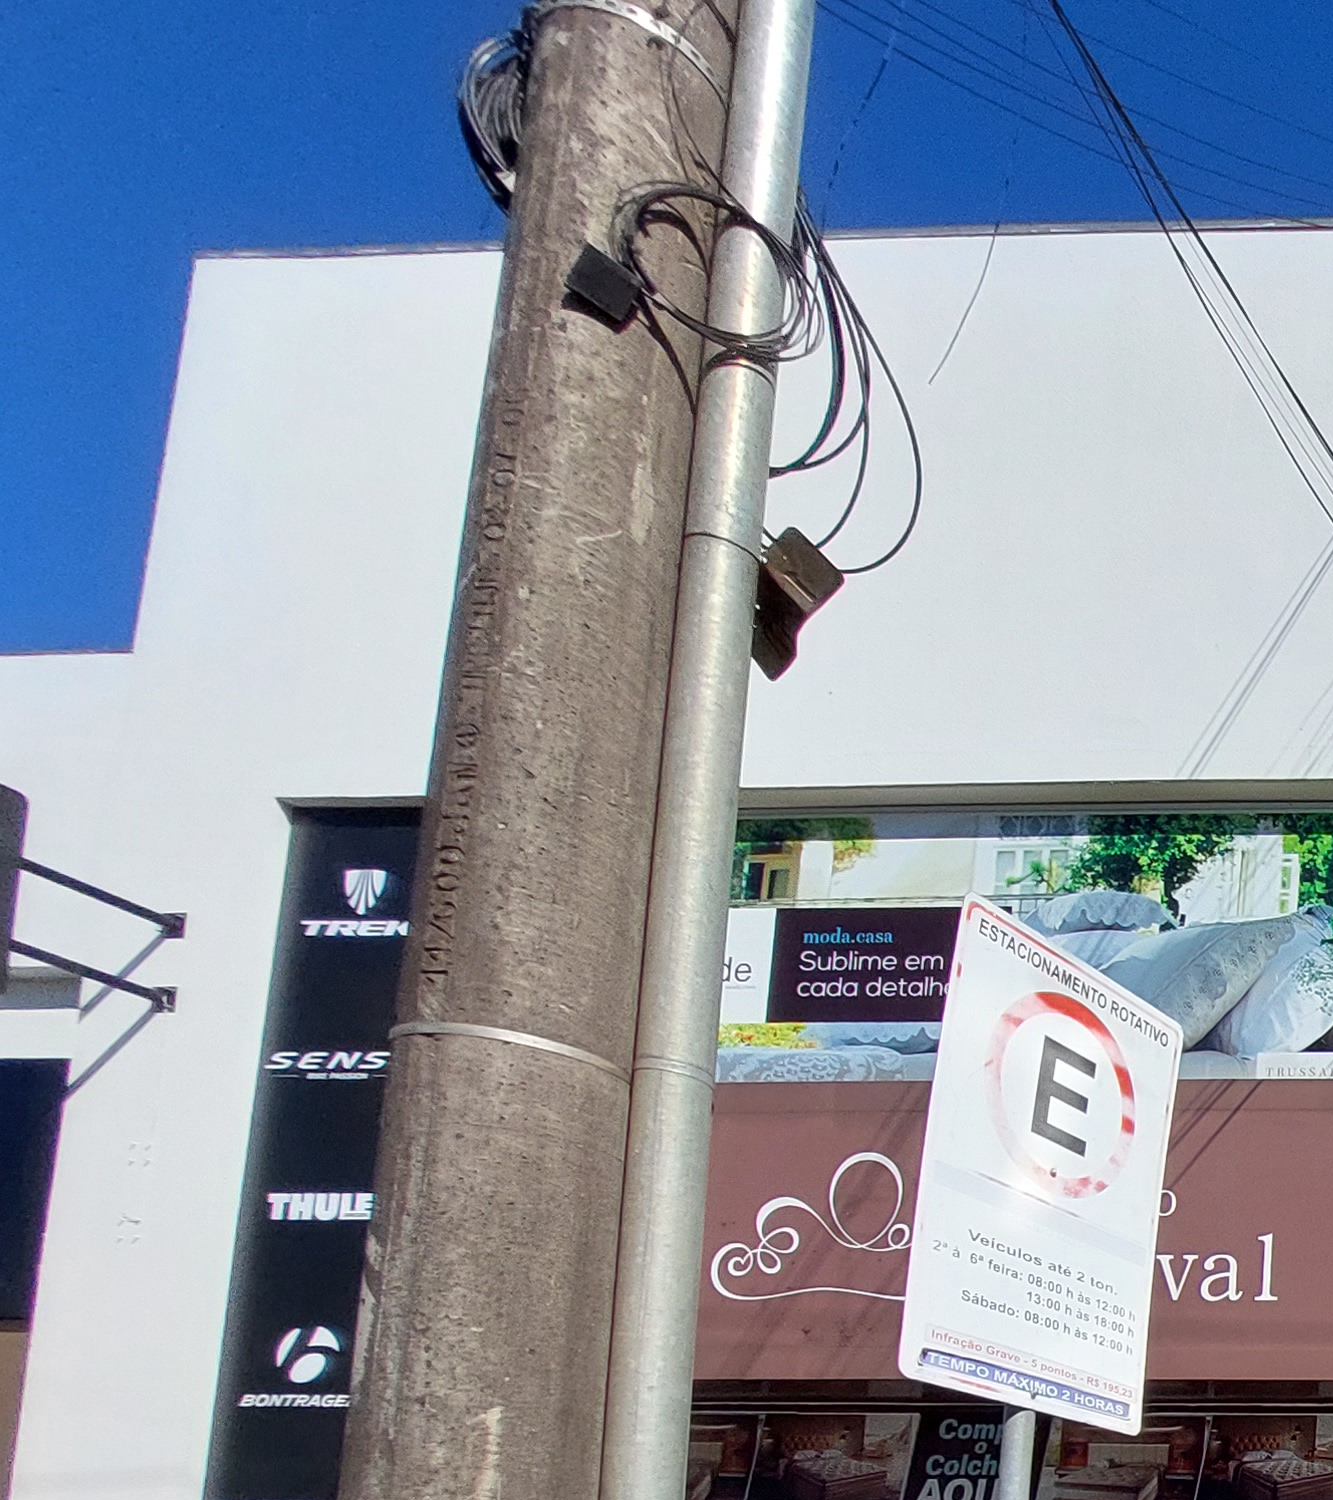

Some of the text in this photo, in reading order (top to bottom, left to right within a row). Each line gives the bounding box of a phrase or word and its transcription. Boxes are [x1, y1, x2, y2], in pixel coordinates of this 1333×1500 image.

[300, 919, 410, 937] TREK
[802, 926, 894, 944] moda.casa
[798, 950, 944, 972] Sublime em
[796, 976, 858, 998] cada
[978, 917, 1169, 1048] ESTACIONAMENTO ROTATIVO
[264, 1051, 392, 1070] SENS
[1030, 1034, 1097, 1158] E
[267, 1193, 375, 1221] THULE
[932, 1239, 948, 1251] 2ª
[969, 1252, 984, 1265] 6ª
[988, 1258, 1024, 1281] feira:
[1027, 1273, 1062, 1295] 08:00
[1066, 1287, 1074, 1300] h
[1078, 1291, 1091, 1306] às
[1095, 1299, 1126, 1319] 12:00
[1129, 1311, 1136, 1323] h
[968, 1229, 1118, 1296] Veículos até 2 ton.
[1156, 1232, 1278, 1302] val
[961, 1289, 1133, 1356] Sábado: 08:00 h às 12:00 h
[1026, 1291, 1135, 1338] 13:00 h às 18:00 h
[931, 1329, 982, 1352] Infração
[986, 1345, 1021, 1364] Grave
[1031, 1359, 1038, 1369] 5
[1040, 1363, 1077, 1381] pontos
[1086, 1375, 1100, 1388] R$
[1103, 1381, 1133, 1399] 195,23
[239, 1394, 351, 1408] BONTRAGE
[927, 1352, 1124, 1416] TEMPO MÁXIMO 2 HORAS
[939, 1418, 1003, 1445] Comp
[926, 1454, 1000, 1476] Colch
